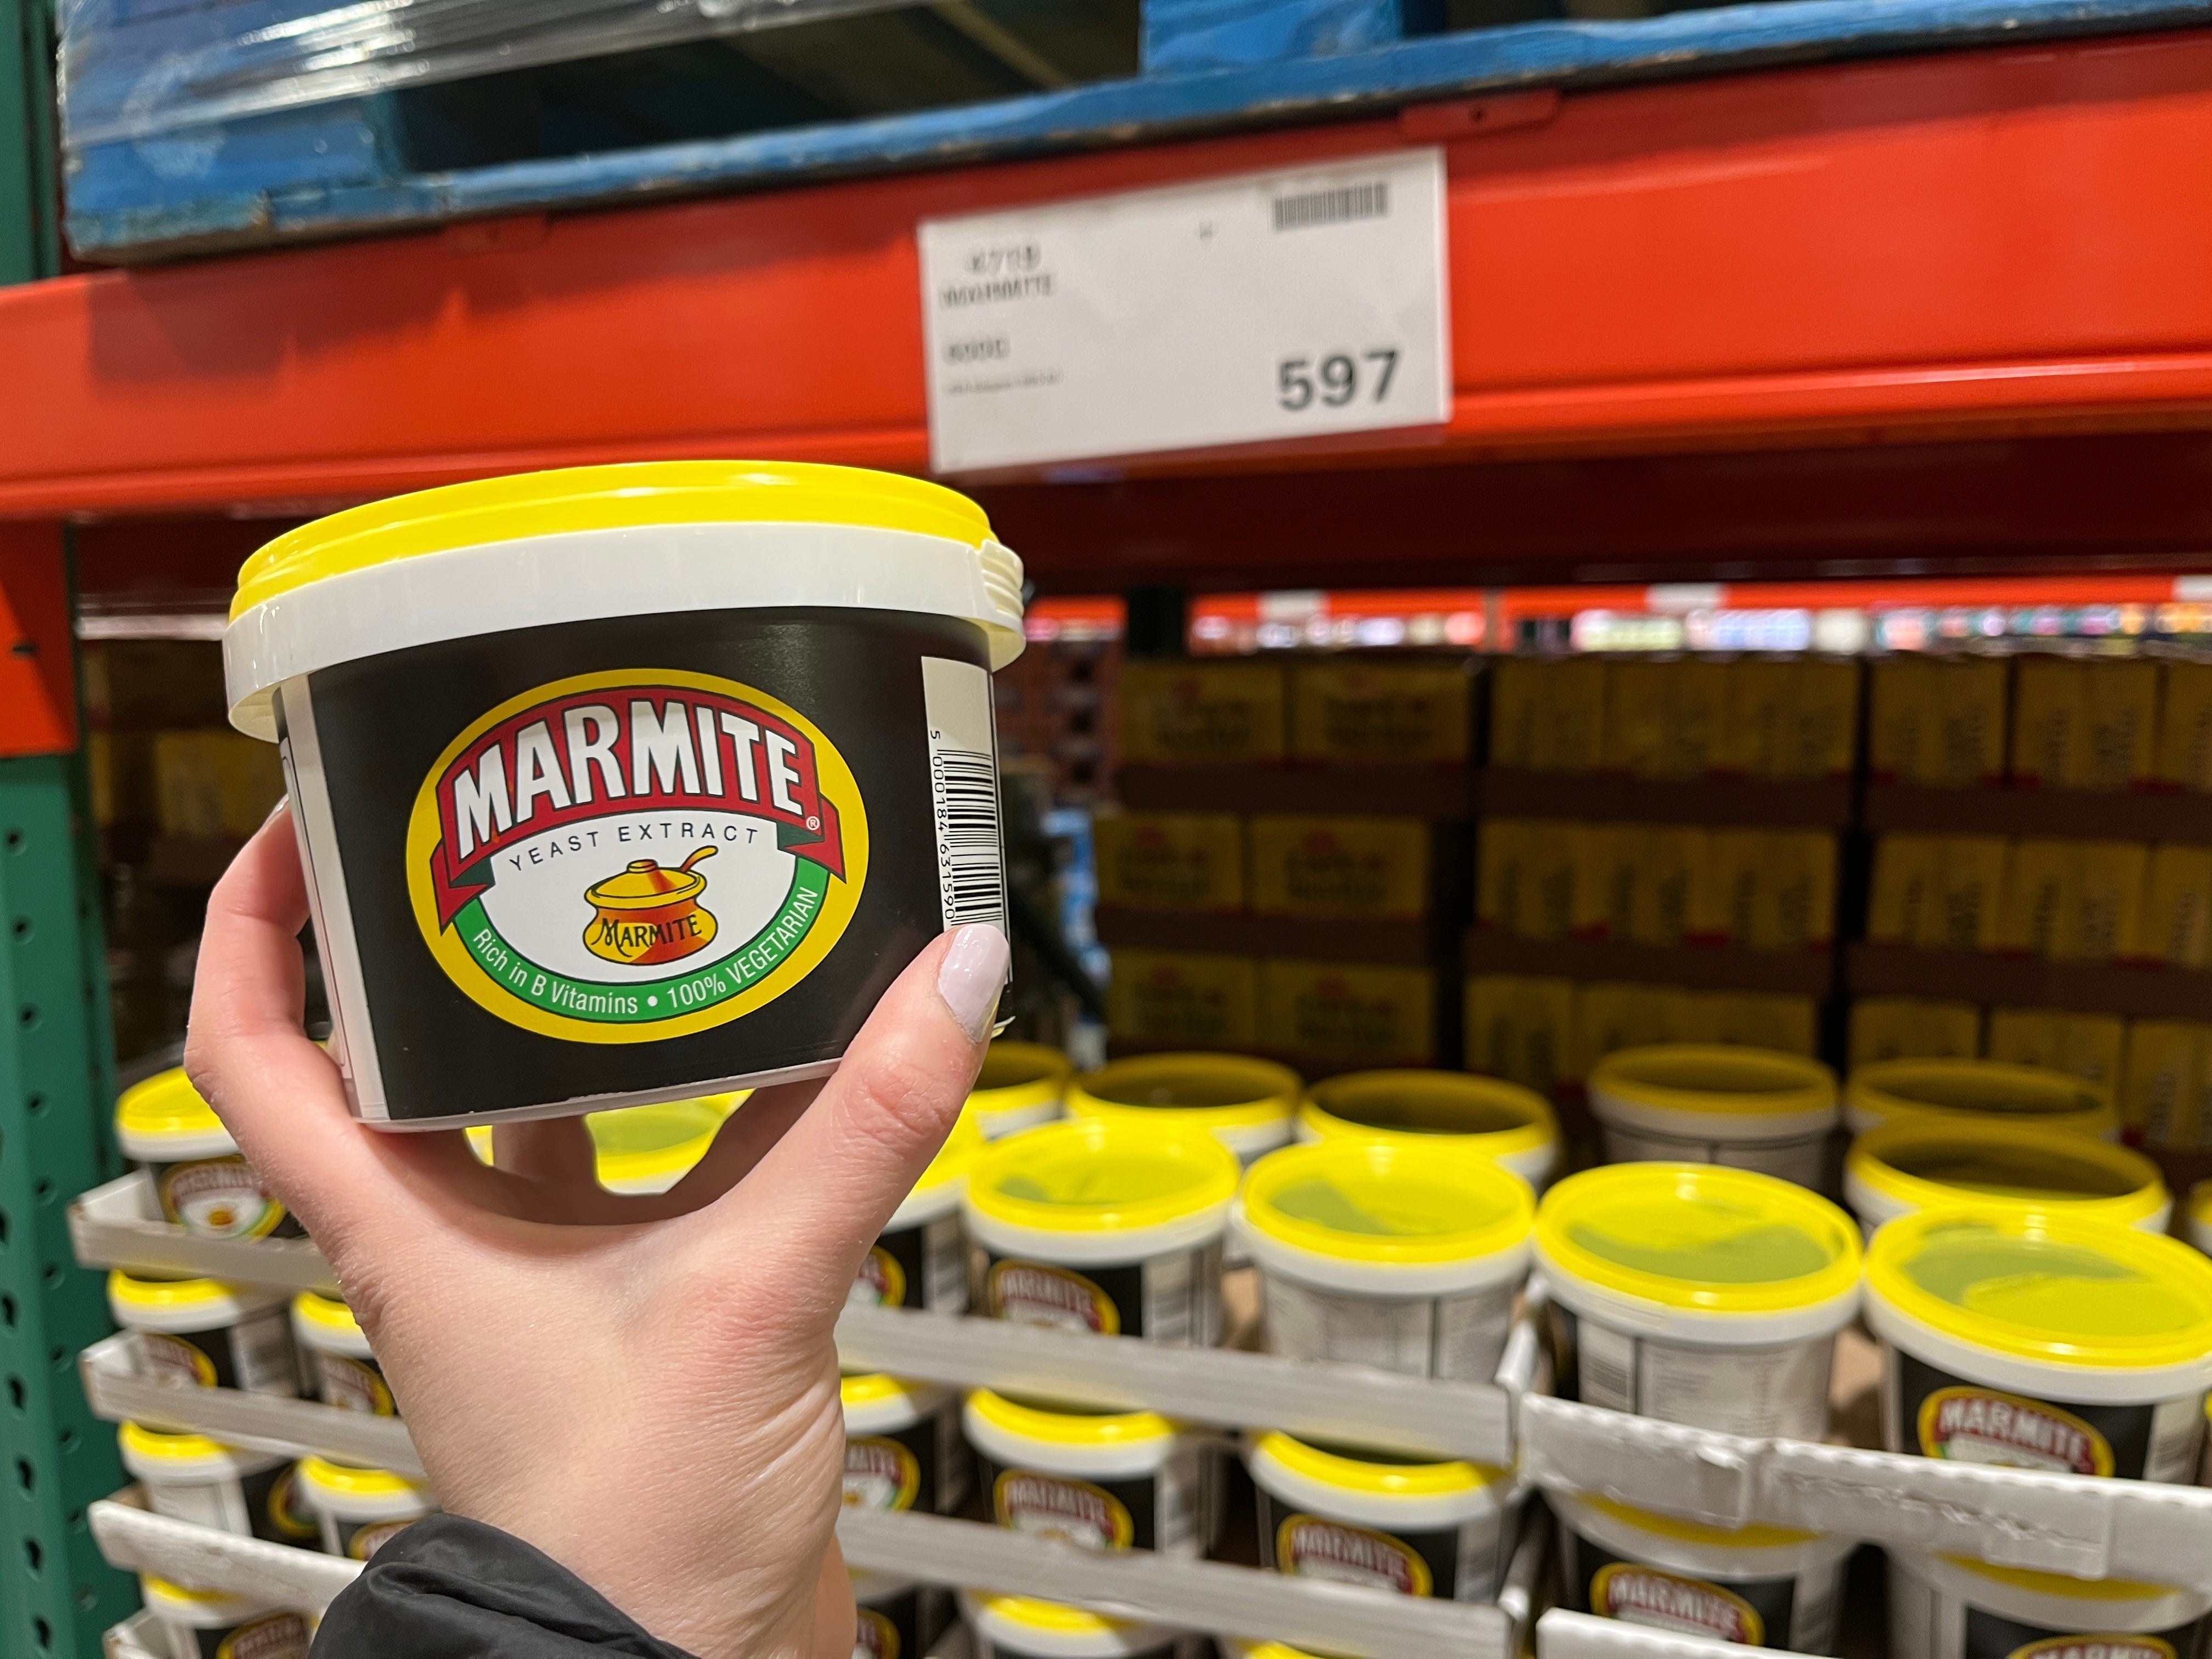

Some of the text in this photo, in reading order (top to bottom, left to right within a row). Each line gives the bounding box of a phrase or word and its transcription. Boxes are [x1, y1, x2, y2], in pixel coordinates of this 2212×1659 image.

[1278, 350, 1400, 411] 597
[453, 698, 804, 860] MARMITE
[509, 822, 759, 872] YEAST EXTRACT
[930, 730, 956, 920] 5 000184 631590
[473, 886, 819, 1014] Rich in B Vitamins 100% VEGETARIAN
[590, 913, 703, 958] MARMITE
[1938, 1398, 2085, 1462] MARMITE
